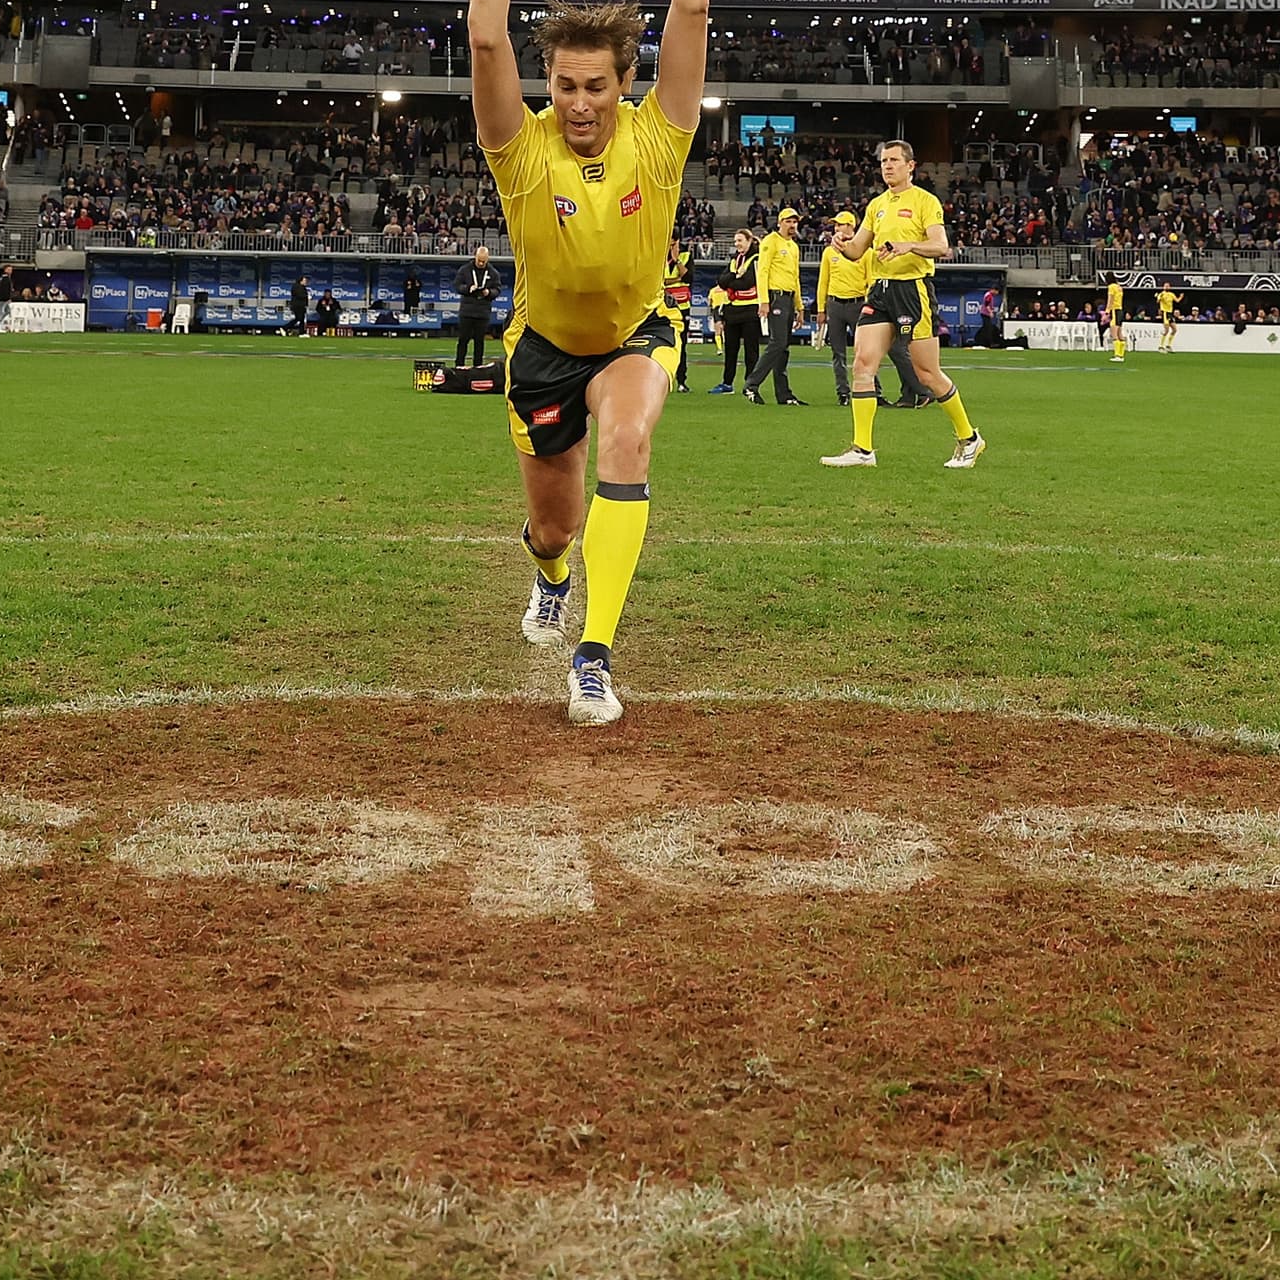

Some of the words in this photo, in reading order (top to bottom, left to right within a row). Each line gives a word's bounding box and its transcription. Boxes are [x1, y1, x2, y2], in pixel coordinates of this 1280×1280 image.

[92, 285, 127, 299] MyPlace
[134, 285, 169, 299] MyPlace
[419, 291, 435, 299] Place
[937, 304, 958, 313] Place
[1028, 327, 1052, 337] HAY
